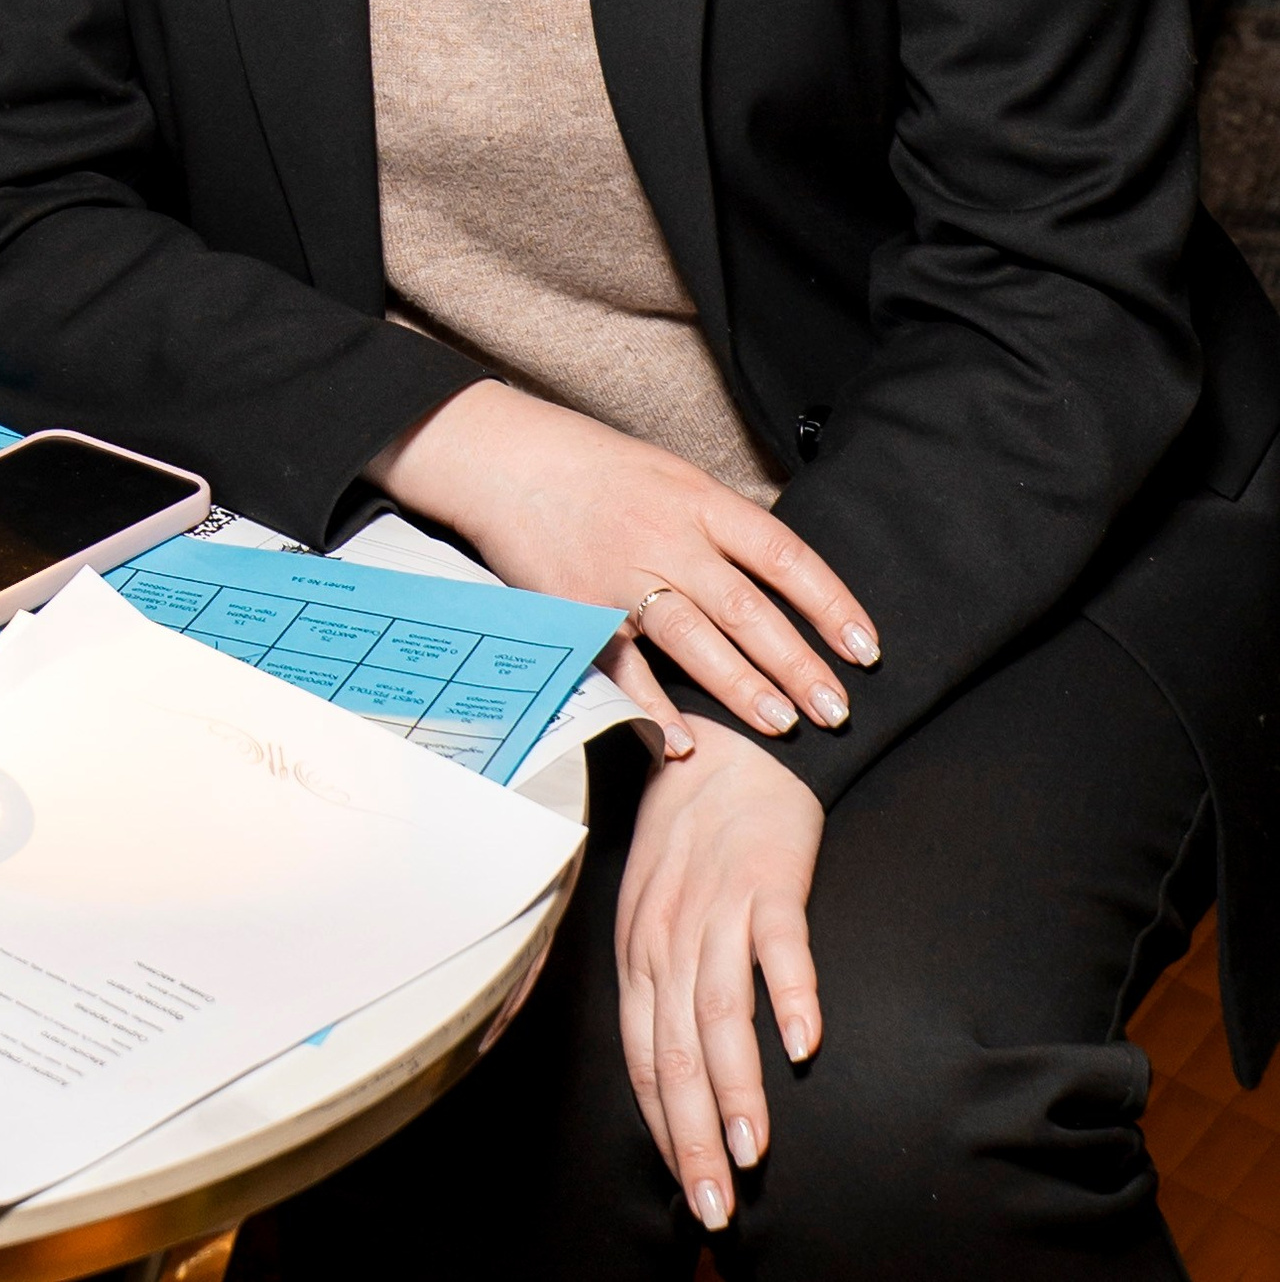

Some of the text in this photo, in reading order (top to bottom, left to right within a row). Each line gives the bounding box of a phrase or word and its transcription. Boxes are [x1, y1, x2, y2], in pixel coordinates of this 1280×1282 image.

[323, 581, 356, 592] Билет
[174, 596, 198, 604] Если
[168, 602, 198, 612] ЮЛИЯ
[226, 610, 266, 622] ТРОФИМ
[298, 616, 348, 629] красавица
[318, 628, 358, 639] ФАКТОР
[391, 638, 421, 647] какой
[399, 647, 440, 658] НАТАЛИ
[494, 654, 536, 664] ТРАКТОР
[293, 675, 334, 686] КОРОЛЬ
[348, 685, 425, 704] QUEST PISTOLS
